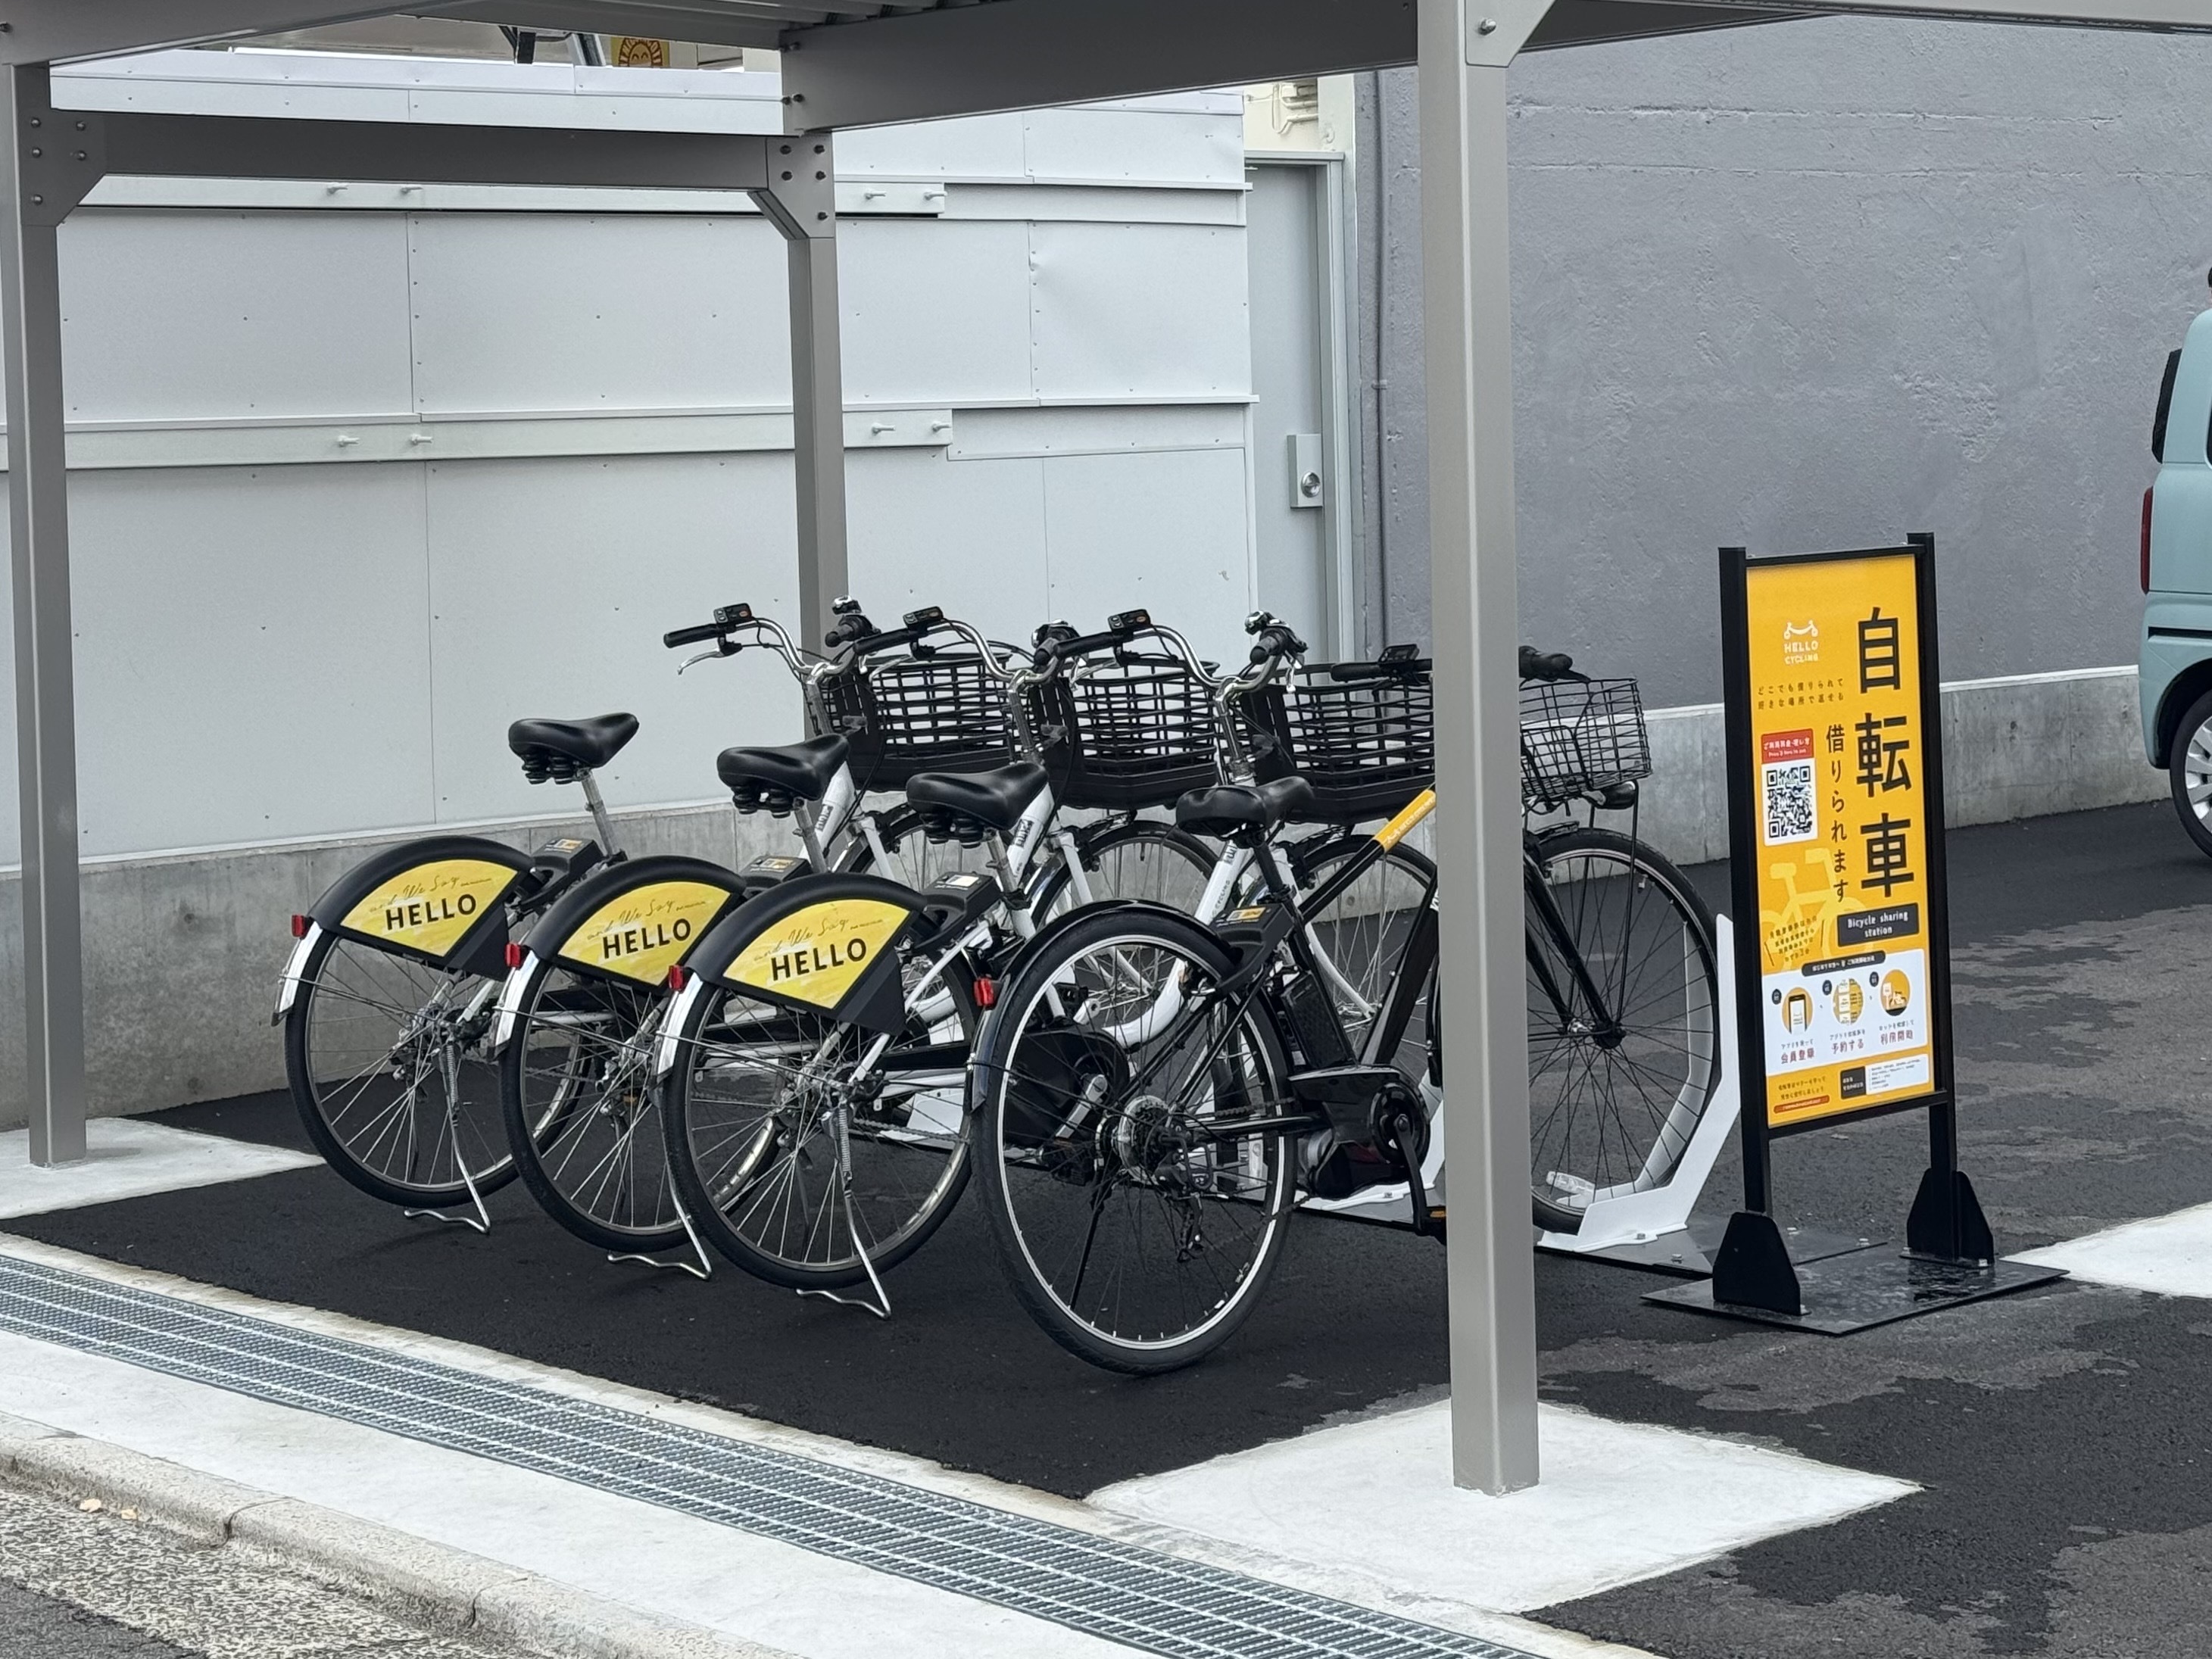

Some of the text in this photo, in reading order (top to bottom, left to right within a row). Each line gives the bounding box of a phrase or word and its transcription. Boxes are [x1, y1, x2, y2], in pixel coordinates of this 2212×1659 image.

[1783, 641, 1819, 653] HELLO
[1784, 653, 1819, 665] CYCLING
[1855, 607, 1914, 898] 自転車
[1826, 724, 1849, 903] 借りられます
[402, 882, 426, 900] We
[385, 893, 477, 931] HELLO
[619, 907, 643, 928] We
[1847, 910, 1908, 928] Bicycle sharing
[603, 918, 691, 959] HELLO
[788, 926, 813, 946] We
[1864, 926, 1893, 938] station
[771, 938, 867, 981] HELLO
